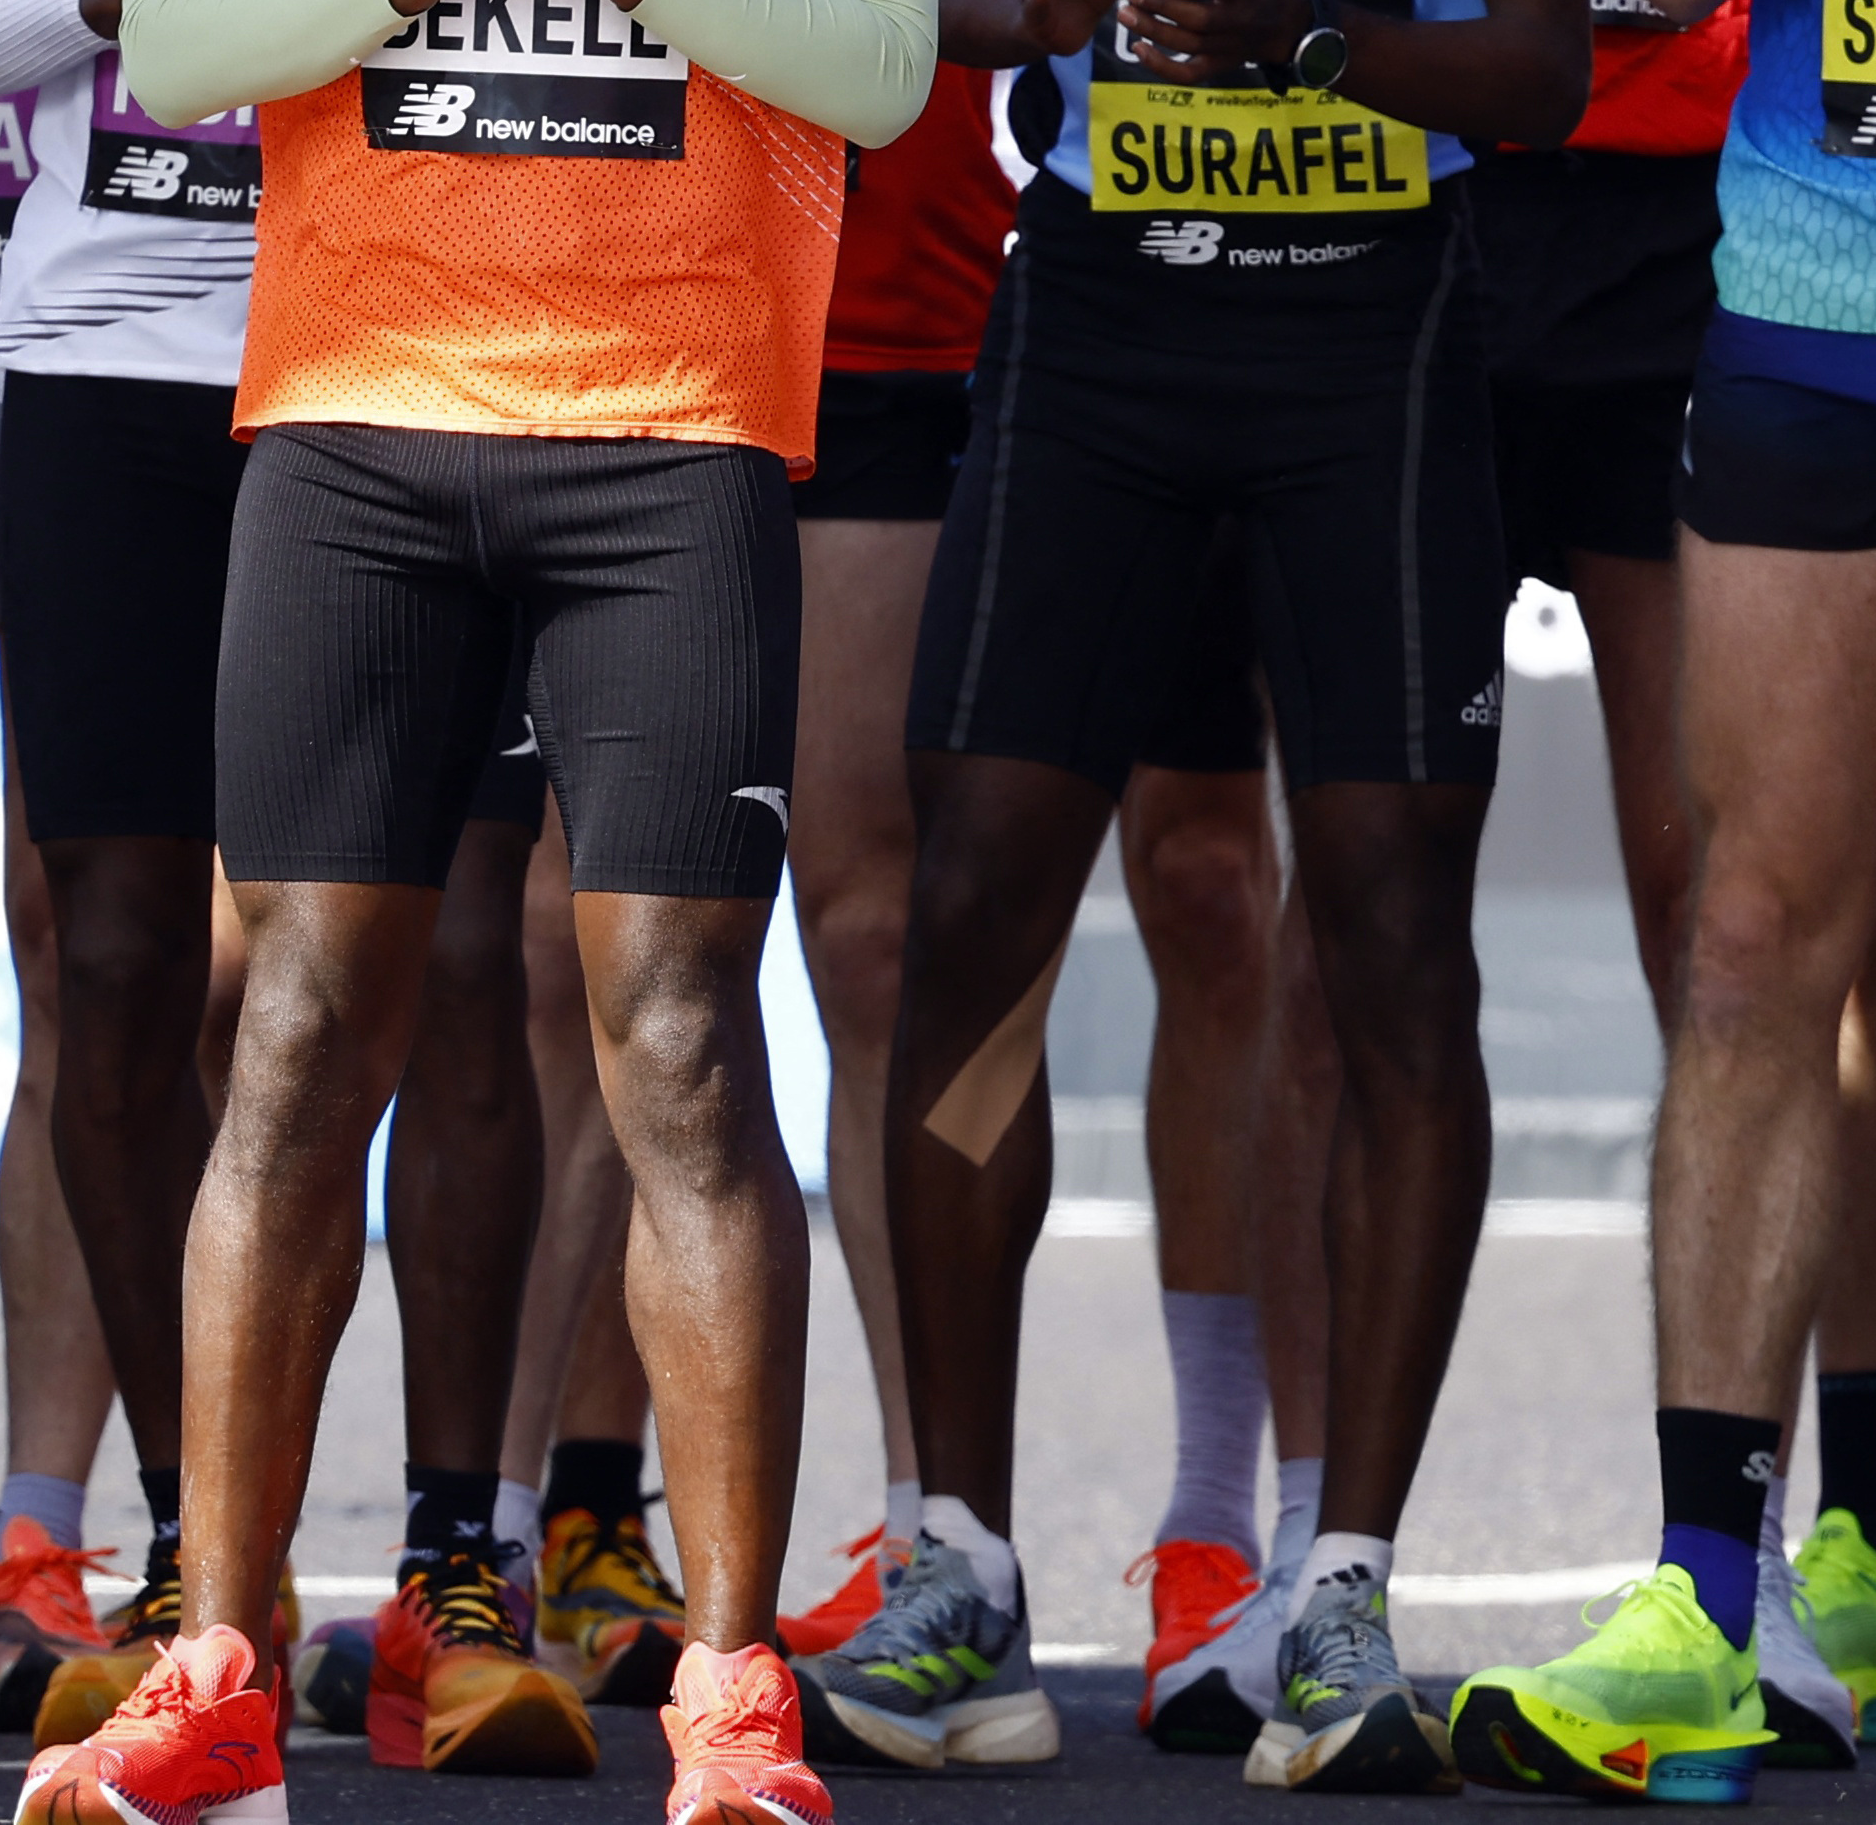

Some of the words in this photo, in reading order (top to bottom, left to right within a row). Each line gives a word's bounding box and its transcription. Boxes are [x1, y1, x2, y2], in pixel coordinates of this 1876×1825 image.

[390, 82, 476, 137] NB
[476, 117, 535, 140] new
[541, 116, 656, 145] balance
[104, 146, 189, 201] NB
[1111, 120, 1409, 197] SURAFEL
[187, 184, 242, 207] new
[1137, 220, 1225, 266] NB
[1228, 246, 1284, 267] new
[1289, 239, 1383, 265] balan
